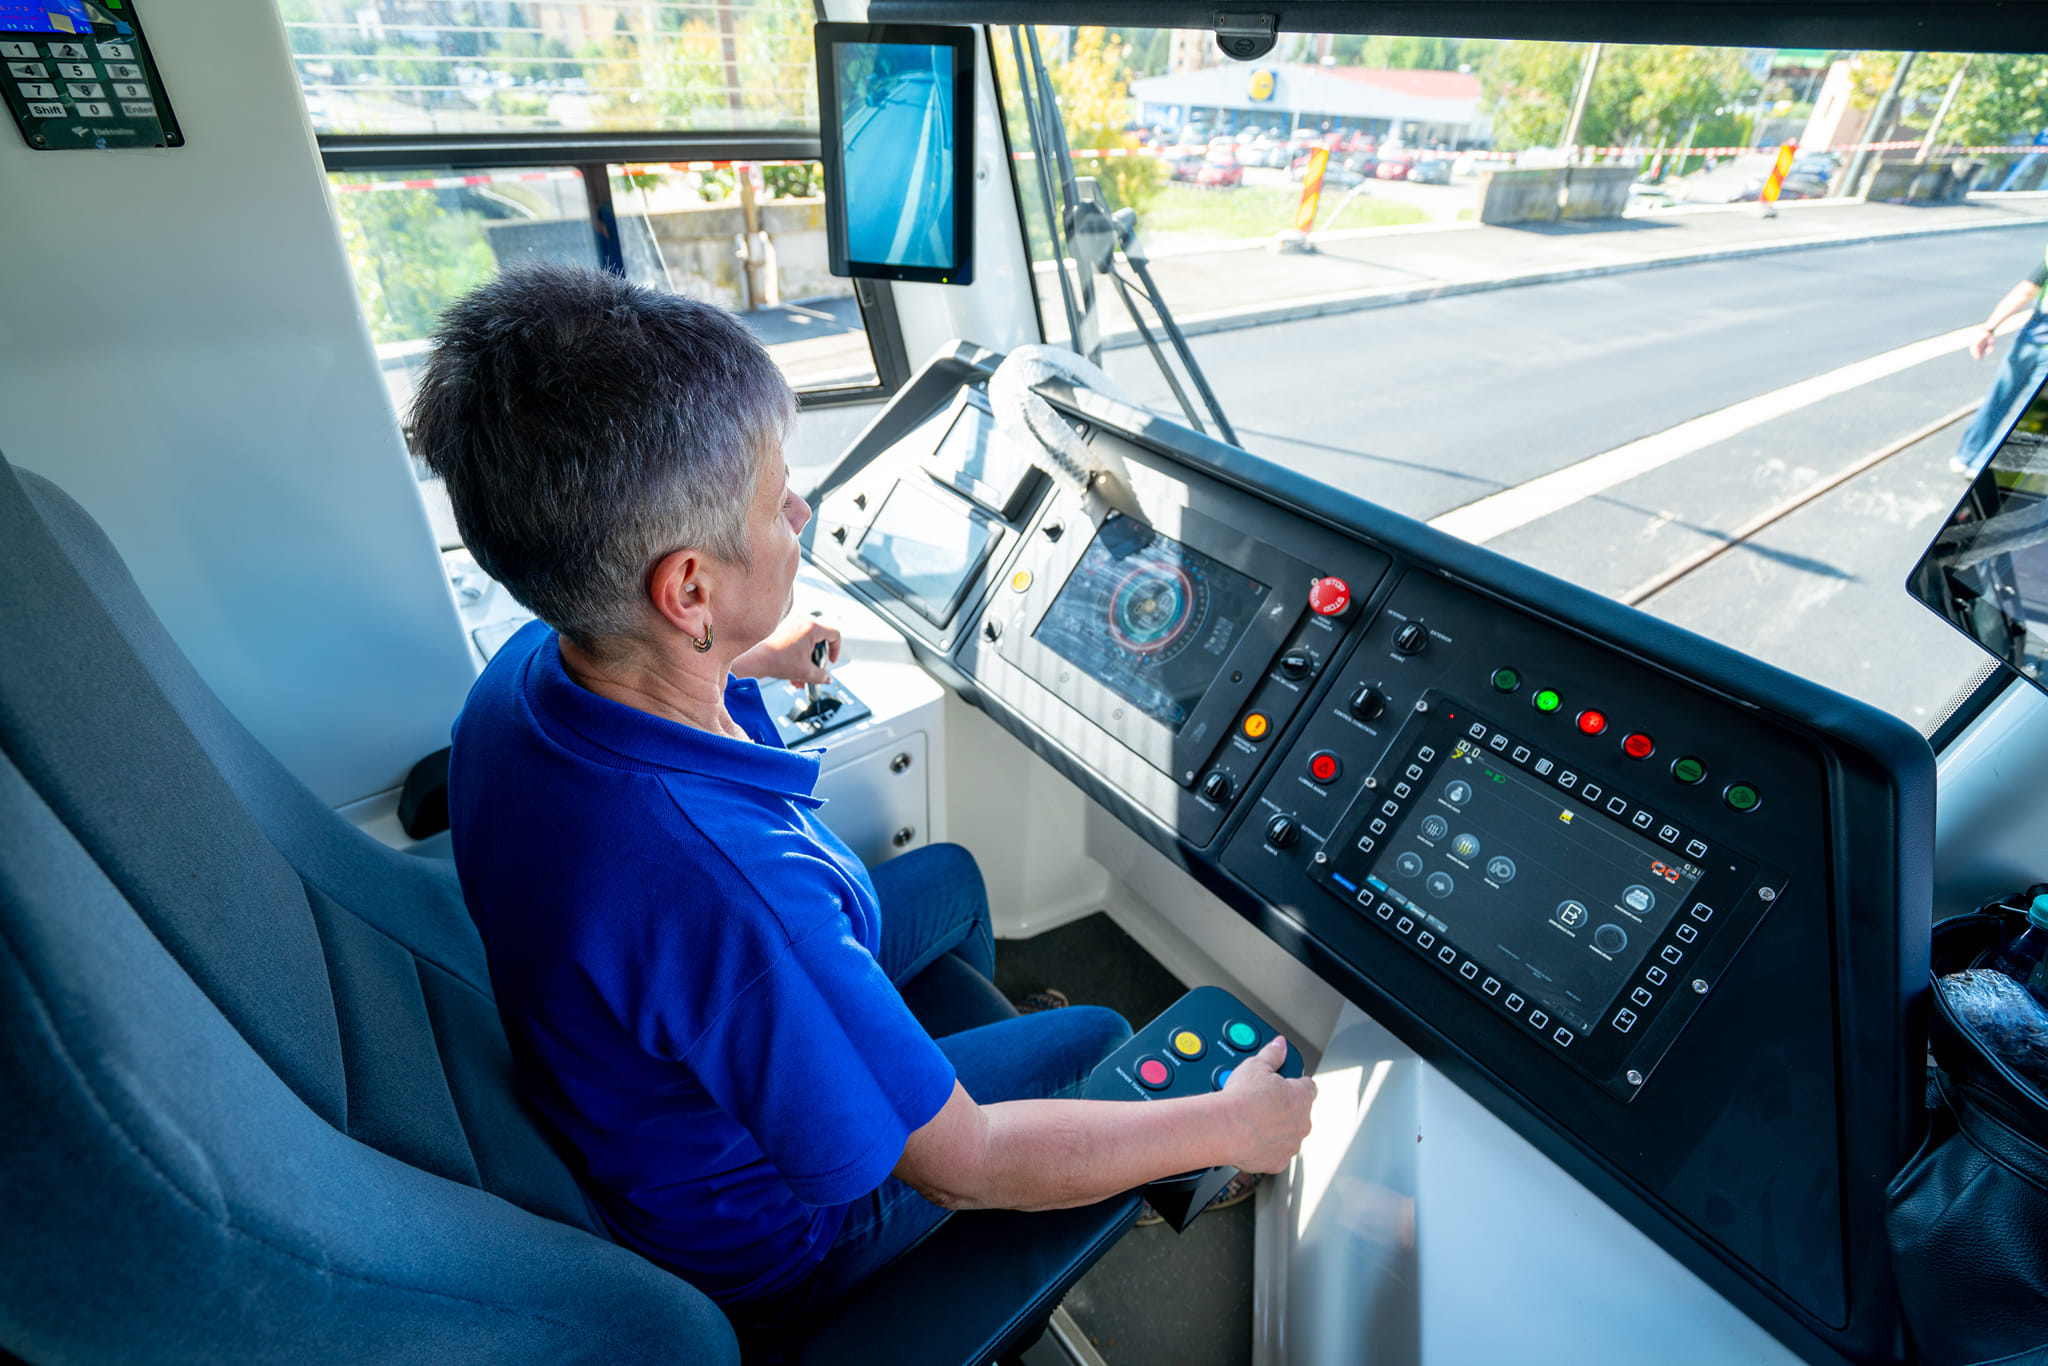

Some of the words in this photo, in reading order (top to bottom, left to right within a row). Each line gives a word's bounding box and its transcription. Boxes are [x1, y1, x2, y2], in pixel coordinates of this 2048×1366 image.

[13, 43, 24, 56] 1
[63, 44, 75, 57] 2
[110, 46, 122, 57] 3
[24, 65, 35, 76] 4
[72, 65, 83, 77] 5
[119, 66, 130, 77] 6
[32, 85, 42, 96] 7
[81, 85, 92, 97] 8
[127, 86, 137, 97] 9
[33, 105, 62, 115] Shift
[89, 104, 100, 115] 0
[124, 105, 153, 114] Enter
[1325, 578, 1346, 592] STOP
[1323, 596, 1345, 613] STOP
